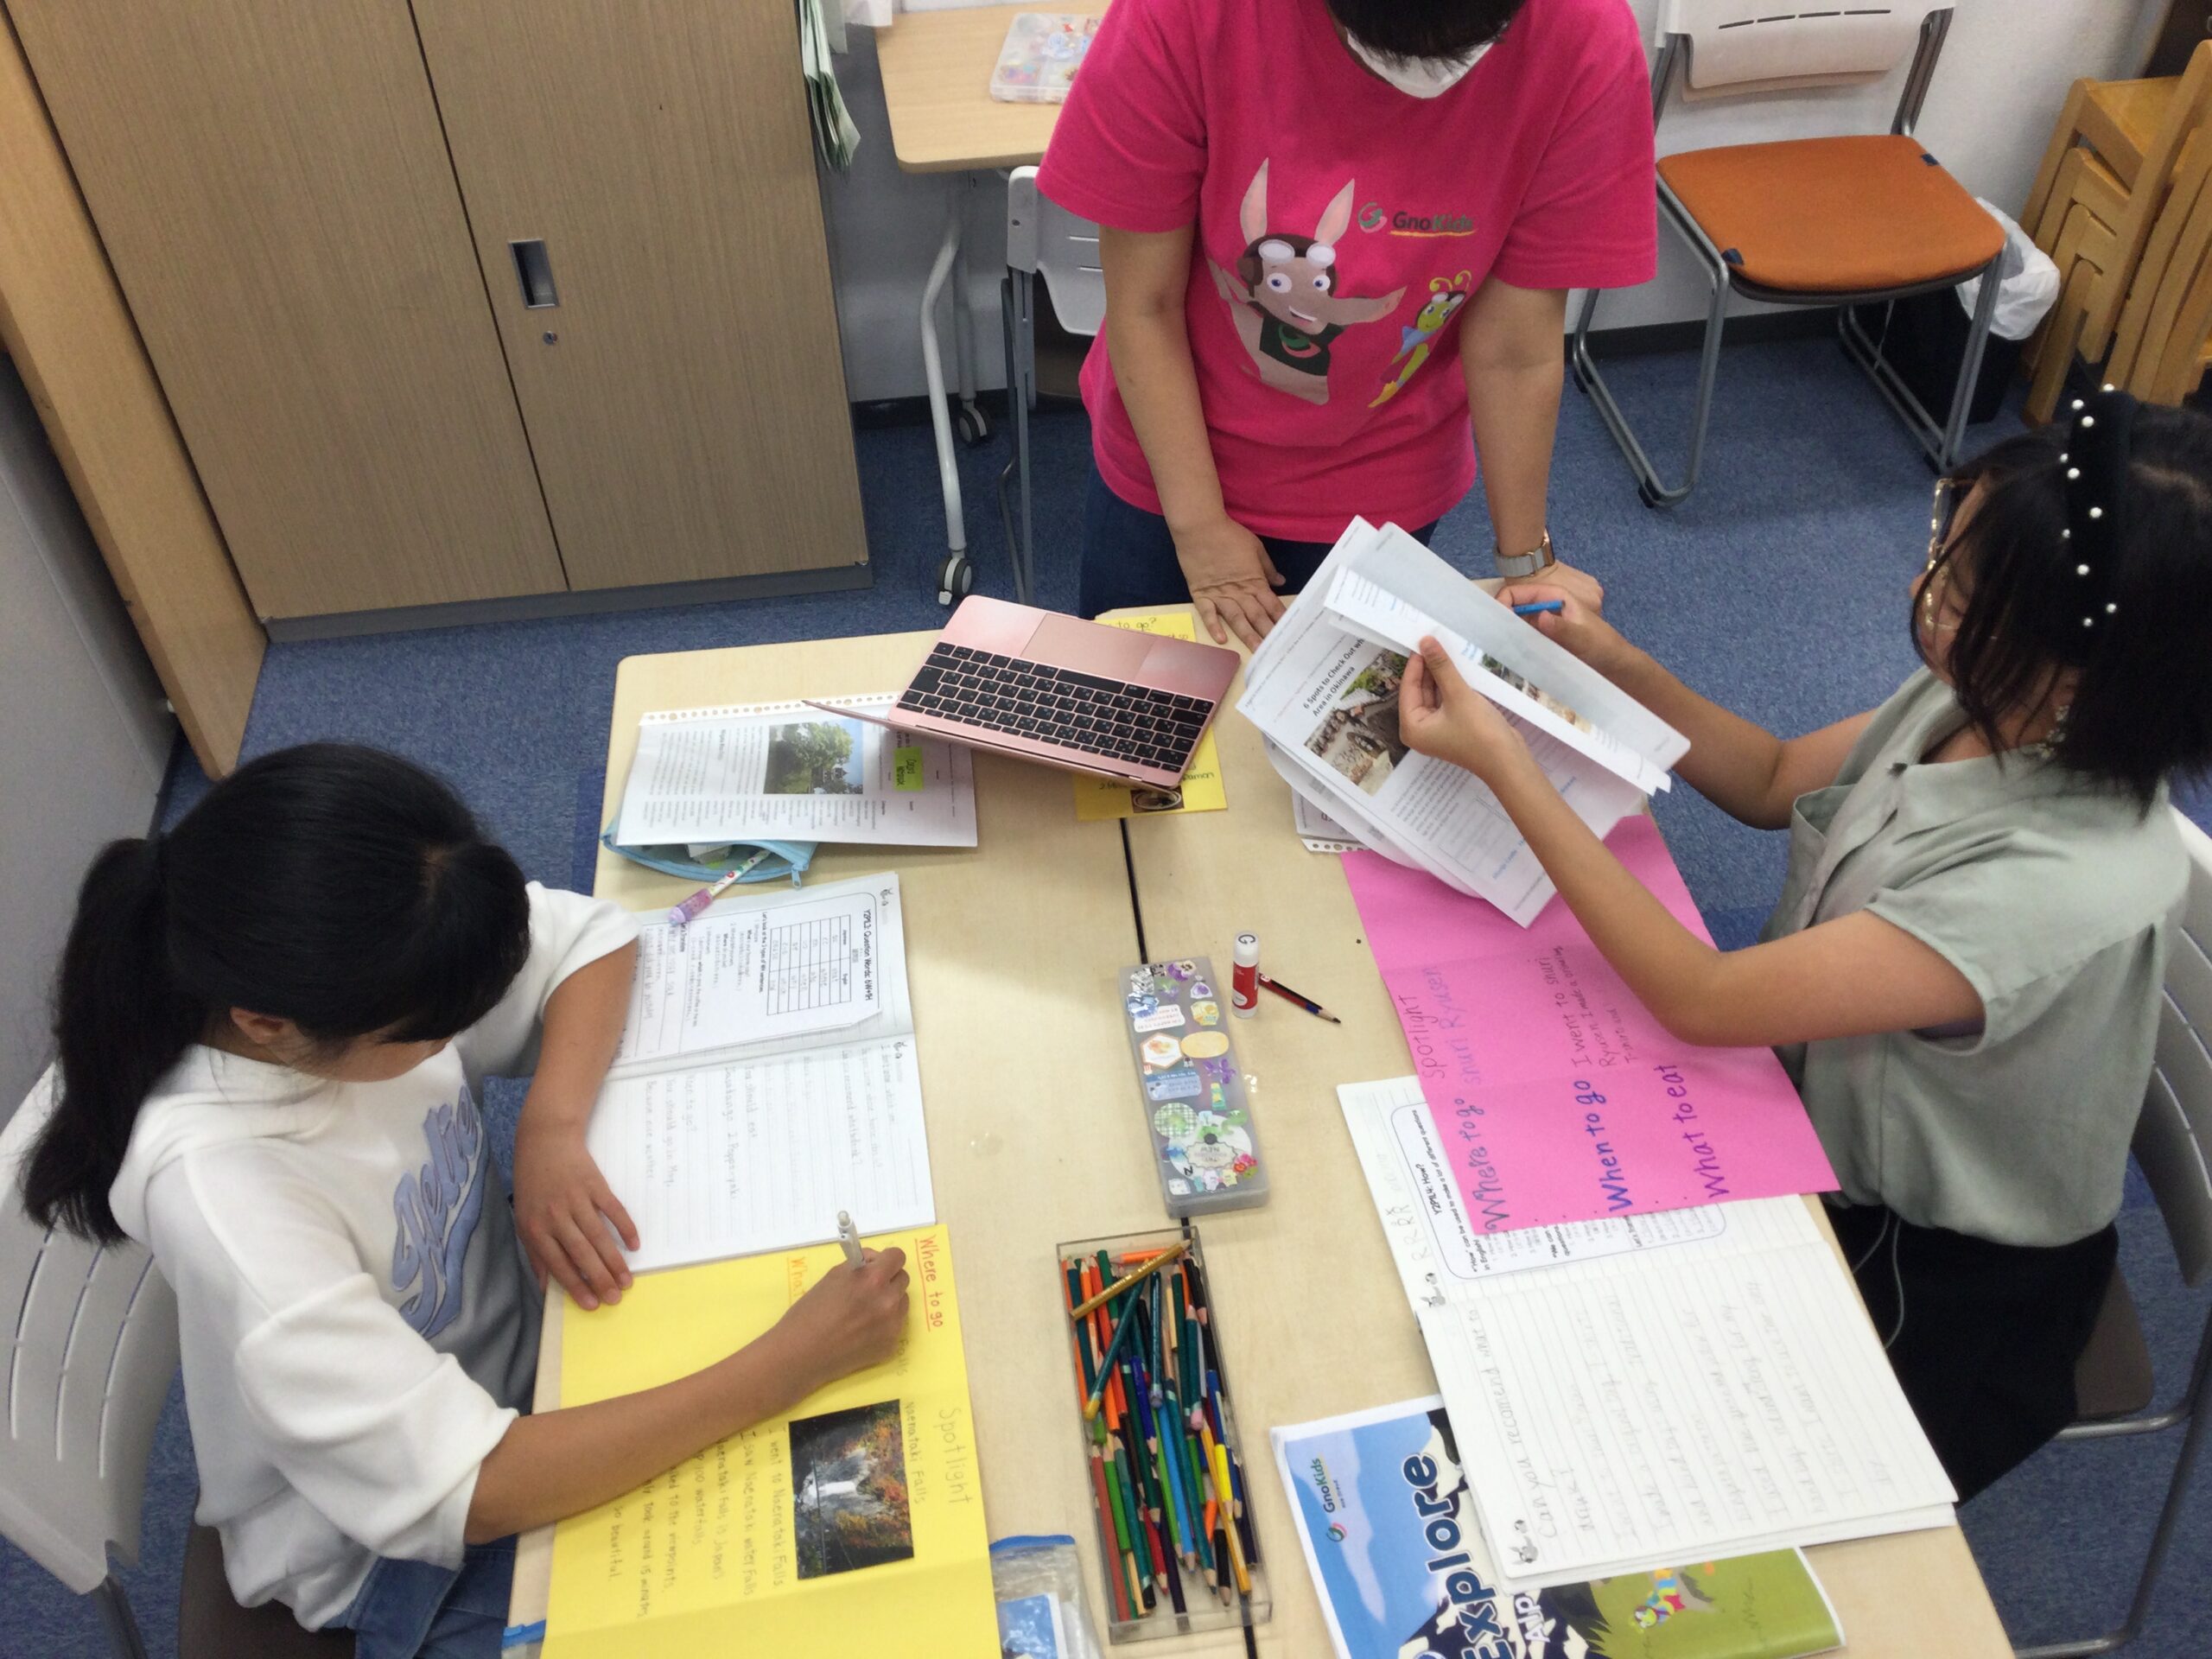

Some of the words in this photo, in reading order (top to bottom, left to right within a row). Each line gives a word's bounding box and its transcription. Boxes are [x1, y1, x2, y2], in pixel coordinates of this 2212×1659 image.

[1306, 685, 1325, 704] Spots
[1321, 677, 1331, 686] to
[1327, 658, 1346, 678] Check
[1343, 647, 1357, 660] Out
[1313, 700, 1327, 717] Area
[1325, 693, 1333, 702] in
[1330, 666, 1356, 694] Okinawa
[862, 931, 872, 957] Question
[863, 958, 872, 978] Words:
[1554, 992, 1568, 1007] to
[1562, 1014, 1586, 1052] went
[1570, 1054, 1592, 1068] I
[1573, 1080, 1607, 1105] go
[1653, 1064, 1688, 1098] eat
[1453, 1097, 1485, 1117] go
[1672, 1102, 1698, 1124] to
[1411, 1109, 1427, 1136] questions
[1458, 1121, 1482, 1142] to
[1585, 1112, 1605, 1137] to
[1421, 1136, 1437, 1160] different
[1414, 1163, 1430, 1185] How?
[1435, 1168, 1444, 1178] lot
[1595, 1141, 1633, 1212] When
[1681, 1132, 1730, 1198] What
[1442, 1183, 1452, 1199] make
[1468, 1146, 1510, 1230] Where
[1450, 1208, 1462, 1224] used
[1462, 1235, 1471, 1248] can
[1544, 1230, 1554, 1243] can
[1552, 1222, 1571, 1256] questions.
[918, 1236, 939, 1283] Where
[1472, 1239, 1488, 1263] English!
[928, 1291, 944, 1307] to
[929, 1312, 944, 1327] go
[932, 1407, 973, 1504] Spotlight
[1516, 1455, 1556, 1491] you
[1310, 1458, 1336, 1514] GnoKids
[1532, 1495, 1559, 1539] Can
